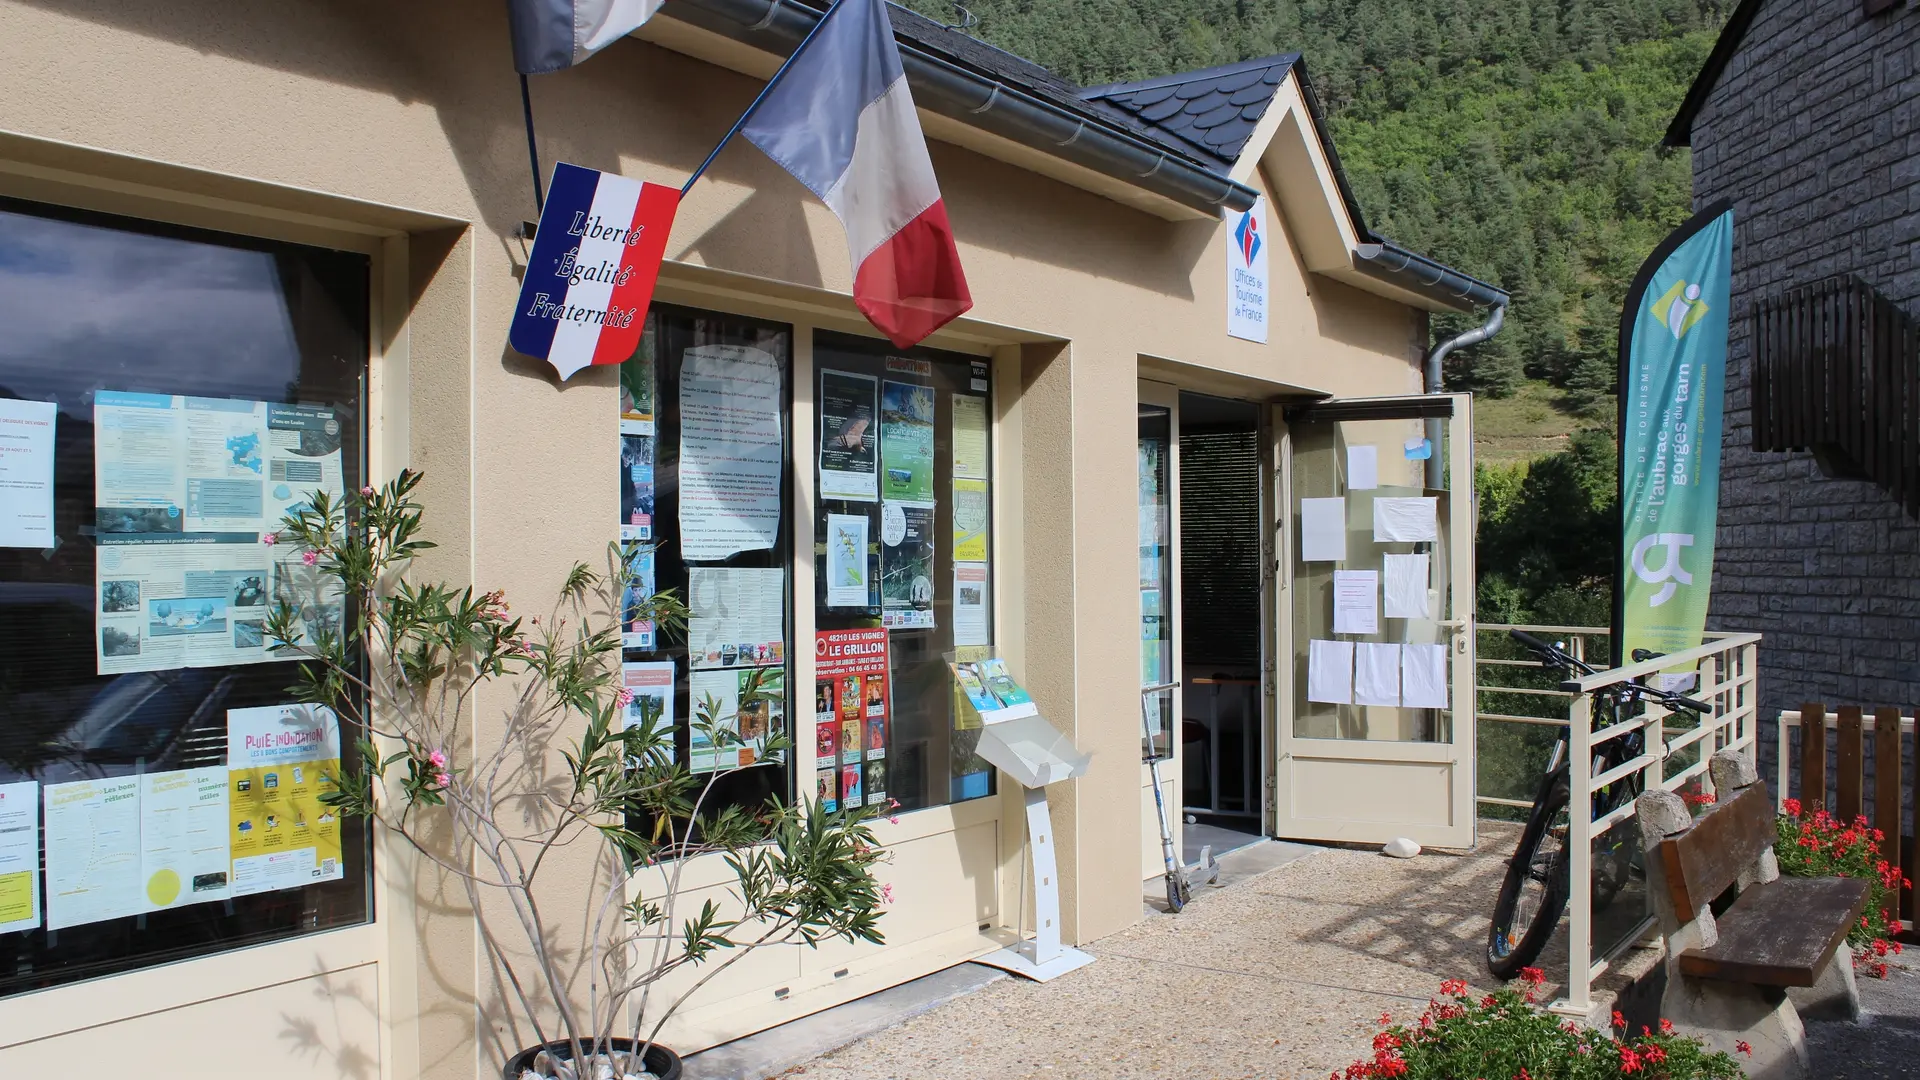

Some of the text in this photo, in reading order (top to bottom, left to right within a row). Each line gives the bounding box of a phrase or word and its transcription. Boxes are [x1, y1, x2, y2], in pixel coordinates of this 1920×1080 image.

[568, 211, 644, 246] Liberté
[555, 247, 633, 286] Égalité
[1234, 268, 1262, 290] Offices de
[1235, 285, 1262, 306] Tourisme
[528, 293, 636, 328] Fraternité
[1235, 304, 1262, 322] de France
[1670, 364, 1690, 486] gorges du tarn
[1636, 364, 1649, 522] OFFICE DE TOURISME
[1647, 408, 1670, 522] de l'aubrac aux
[829, 642, 884, 657] LE GRILLON
[246, 728, 323, 749] PLUIE-INONDATION
[279, 744, 318, 754] COMPORTEMENTS
[104, 792, 134, 803] réflexes
[118, 783, 136, 792] bons
[199, 792, 220, 801] utiles
